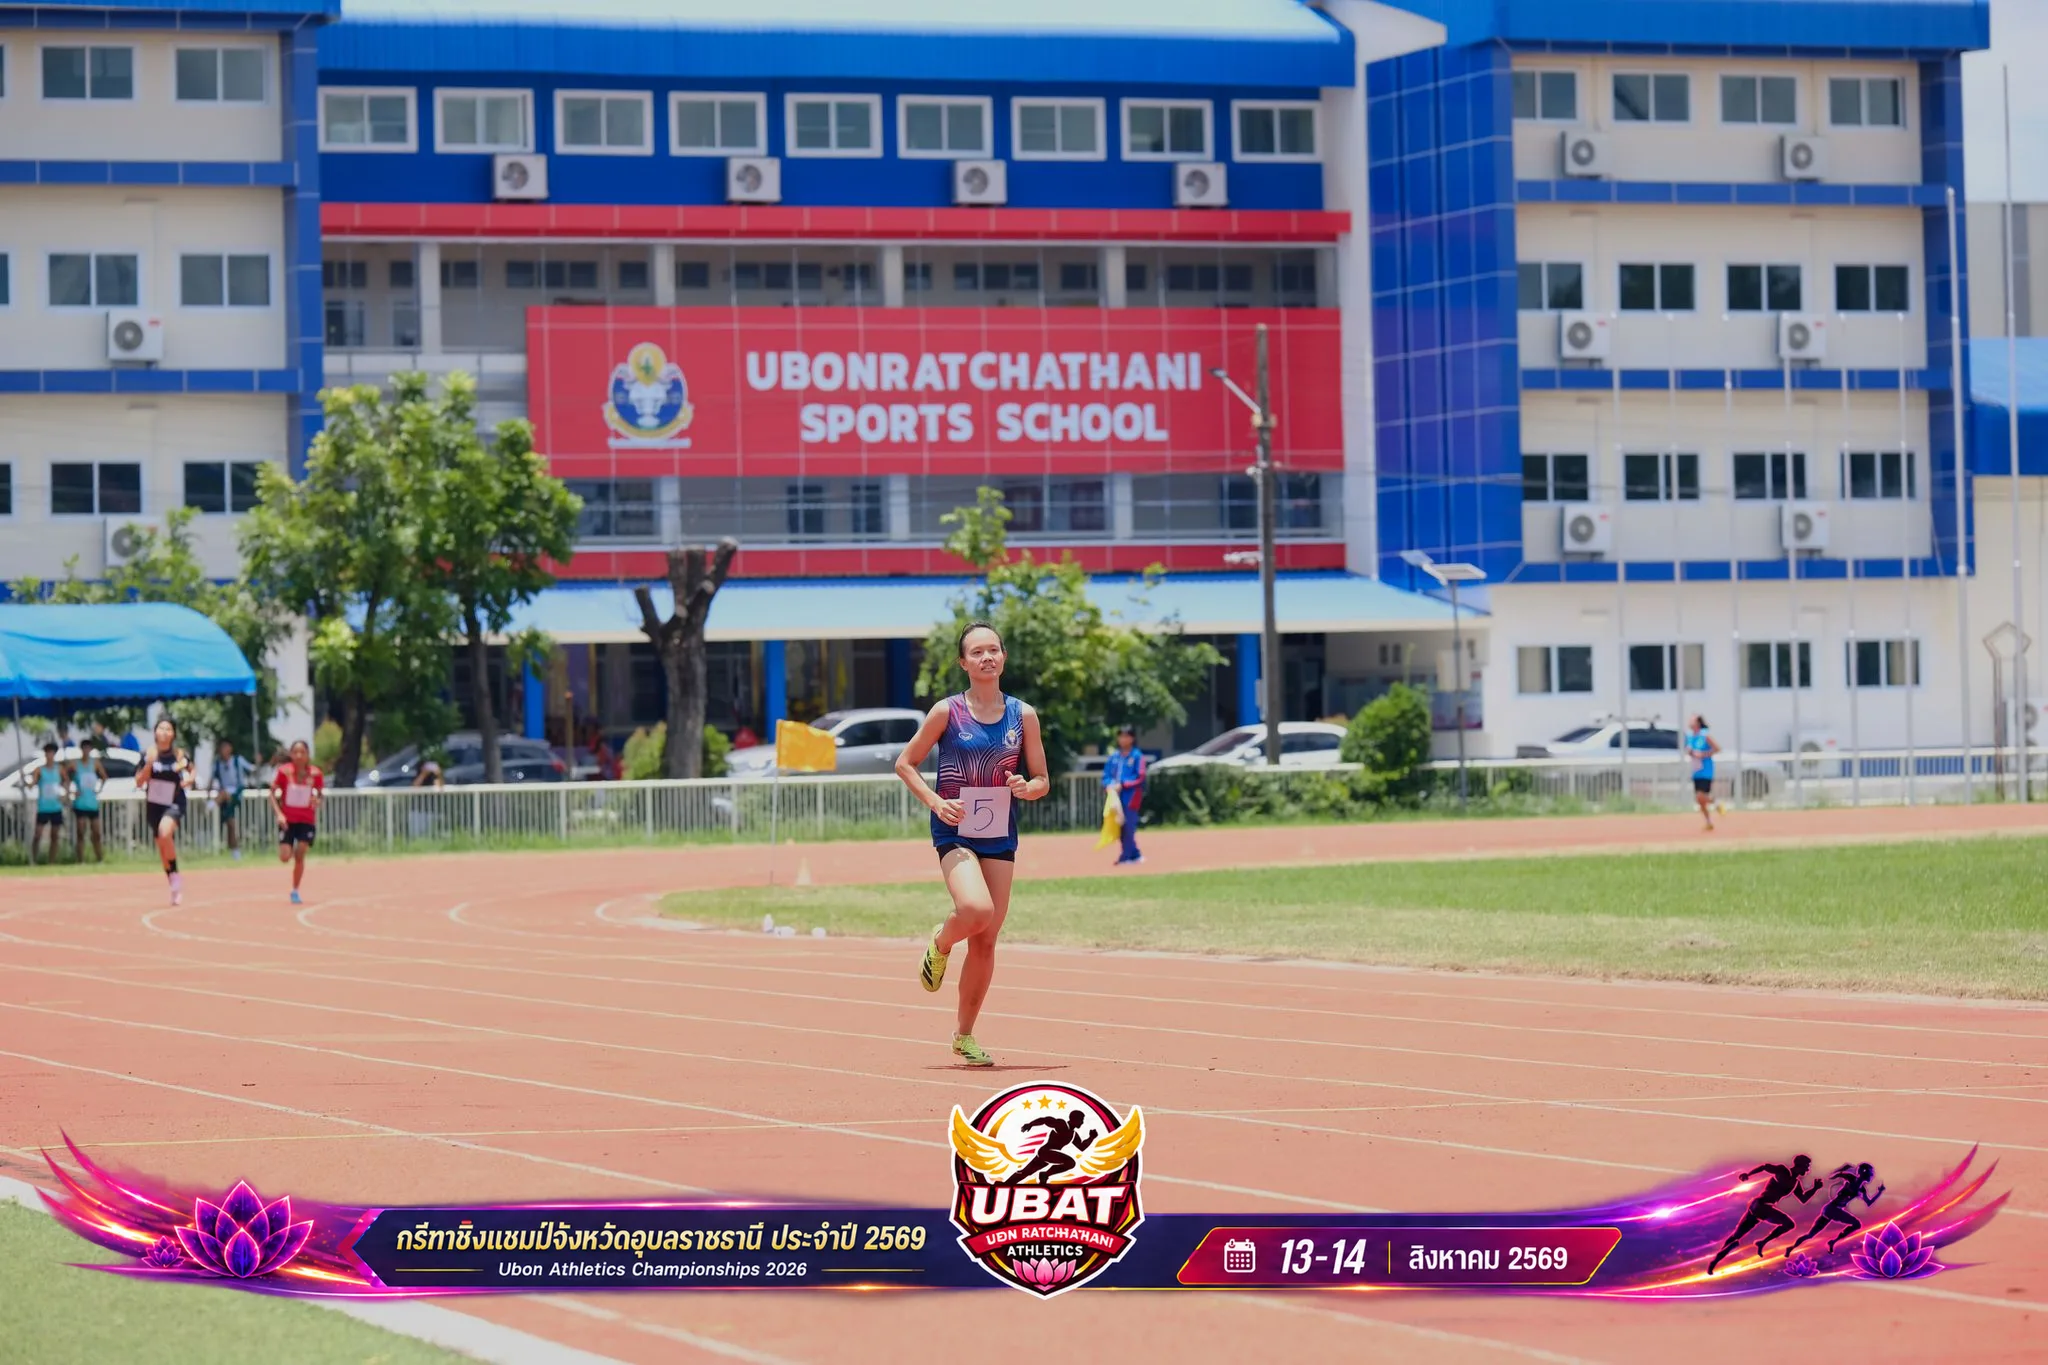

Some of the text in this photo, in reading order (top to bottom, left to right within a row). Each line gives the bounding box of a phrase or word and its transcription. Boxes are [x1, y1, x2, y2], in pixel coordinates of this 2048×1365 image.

[746, 352, 1201, 391] UBONRATCHATHANI
[801, 402, 1168, 443] SPORTS SCHOOL
[974, 798, 994, 832] 5
